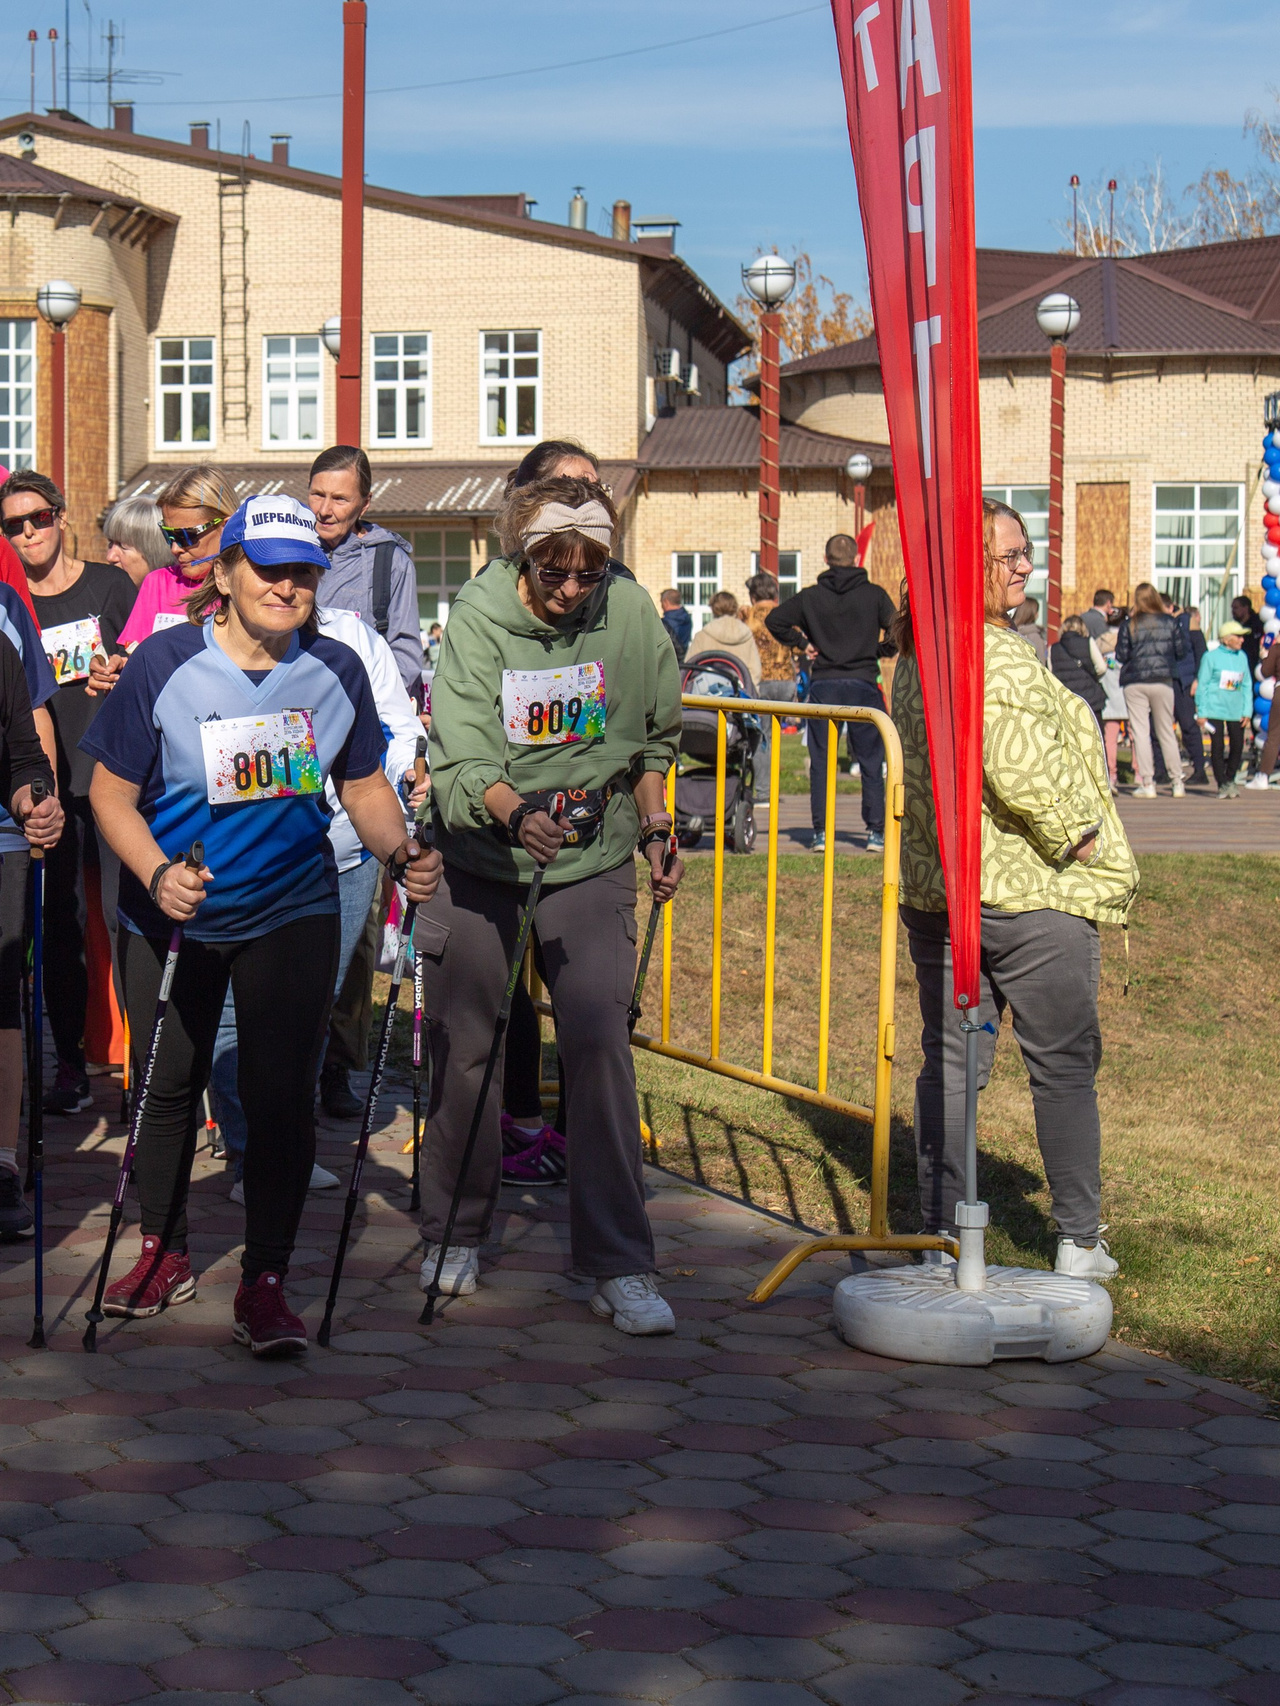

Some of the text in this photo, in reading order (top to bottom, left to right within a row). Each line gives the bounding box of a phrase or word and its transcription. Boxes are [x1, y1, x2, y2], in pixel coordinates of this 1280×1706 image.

[528, 697, 582, 736] 809
[233, 747, 292, 791] 801
[506, 960, 521, 998] SPIN
